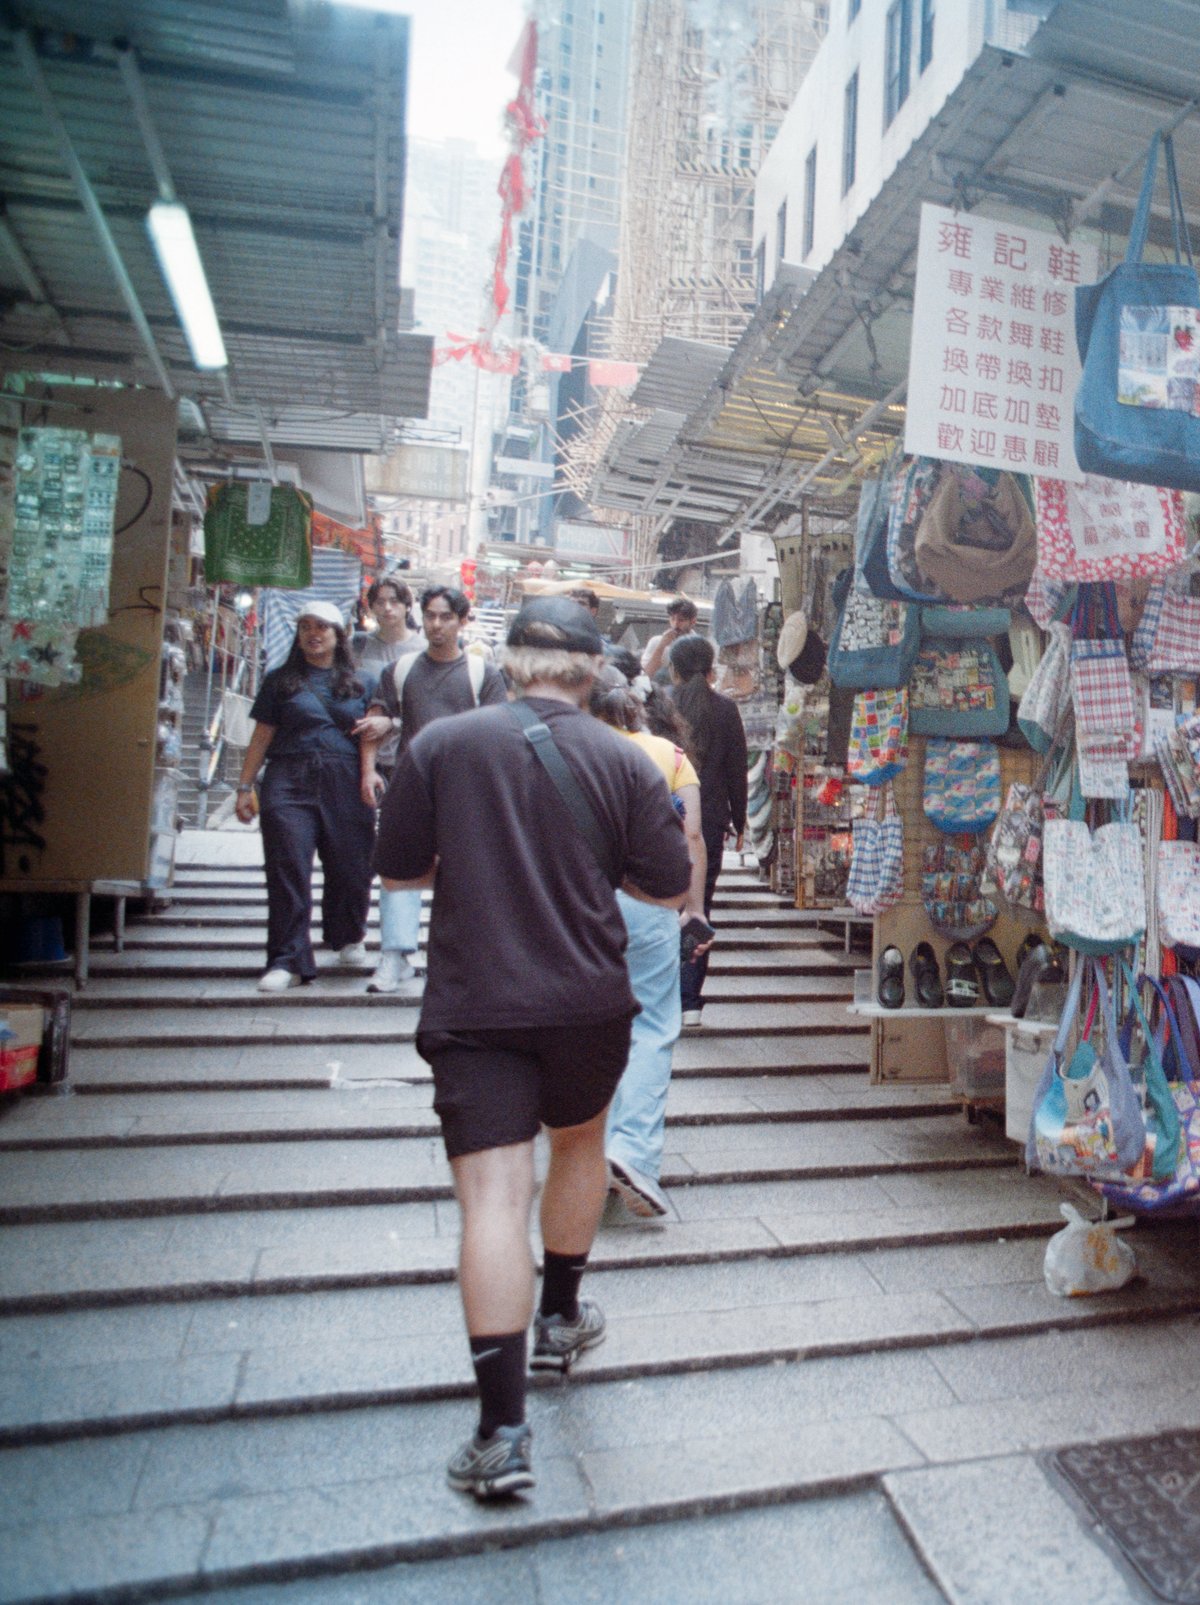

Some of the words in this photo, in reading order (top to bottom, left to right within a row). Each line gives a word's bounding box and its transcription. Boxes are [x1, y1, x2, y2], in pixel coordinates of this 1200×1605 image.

[947, 268, 1068, 317] 專業維修
[945, 306, 1065, 356] 各款舞鞋
[942, 346, 1063, 393] 換帶換扣
[939, 383, 1061, 432] 加底加墊
[937, 422, 1059, 469] 歡迎惠顧
